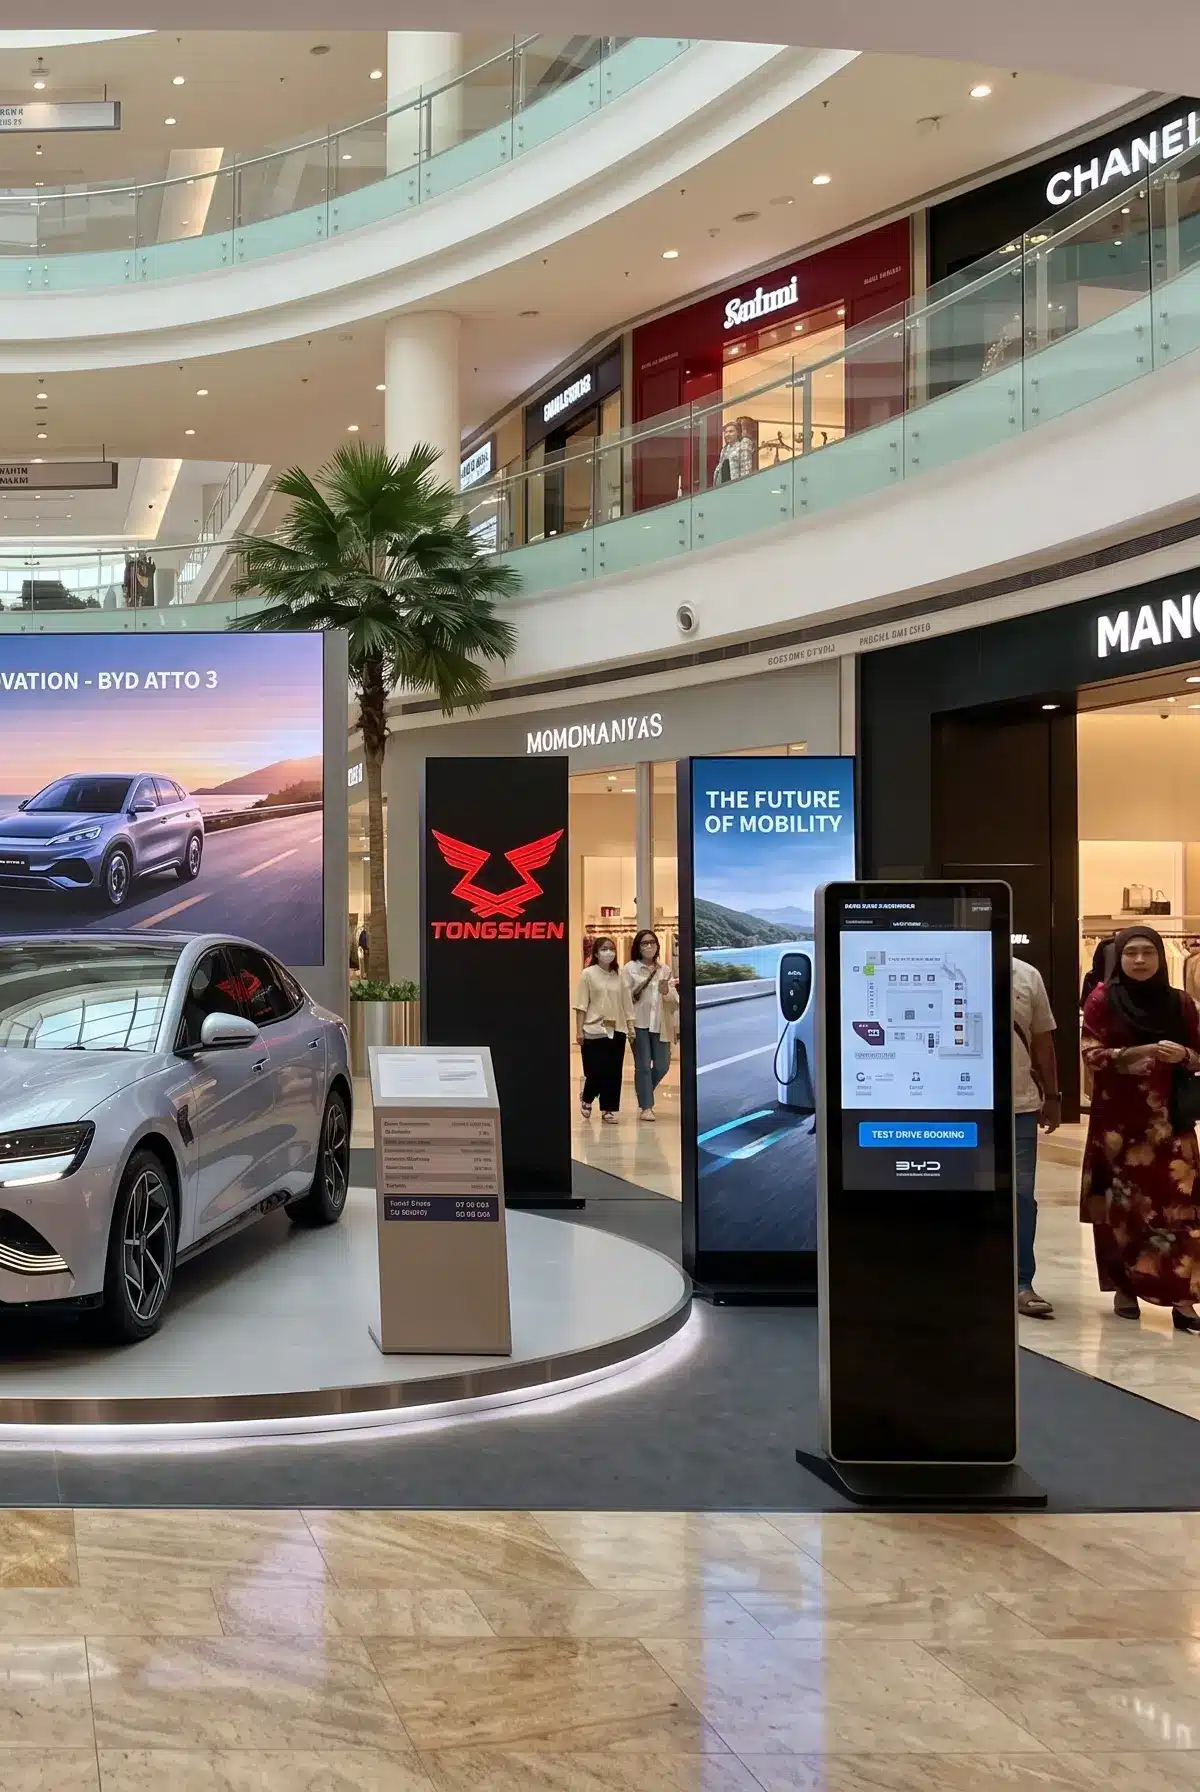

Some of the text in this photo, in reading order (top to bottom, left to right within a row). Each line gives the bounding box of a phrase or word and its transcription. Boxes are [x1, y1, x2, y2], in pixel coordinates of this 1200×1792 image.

[98, 671, 139, 690] BYD
[144, 671, 200, 689] ATTO
[205, 670, 218, 689] 3
[705, 790, 841, 808] THE FUTURE
[704, 815, 842, 833] OF MOBILITY
[430, 922, 564, 939] TONGSHEN
[872, 1130, 965, 1139] TEST DRIVE BOOKING
[896, 1161, 941, 1171] BYD
